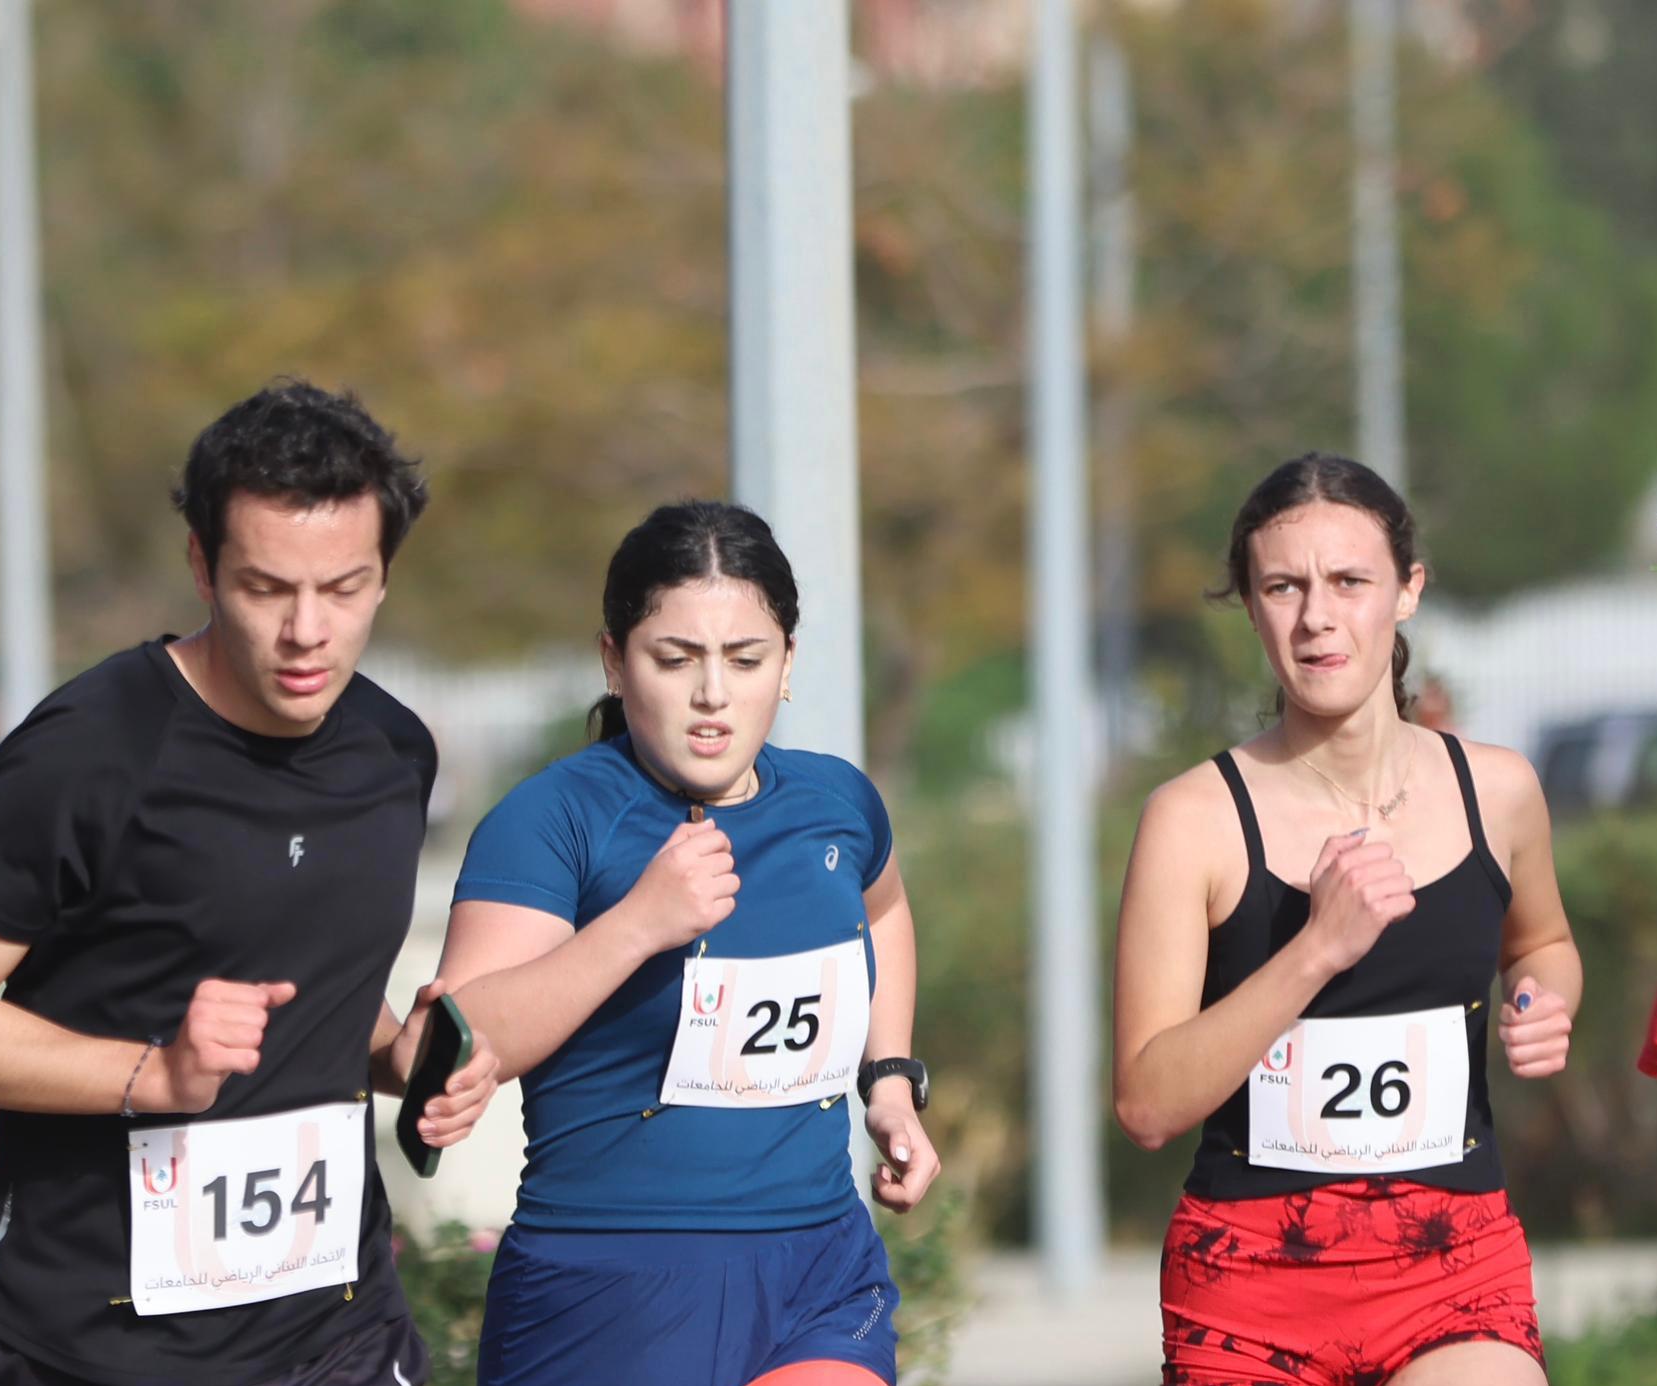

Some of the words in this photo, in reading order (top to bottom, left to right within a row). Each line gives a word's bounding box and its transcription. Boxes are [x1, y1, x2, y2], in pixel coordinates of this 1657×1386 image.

[689, 1018, 719, 1028] FSUL
[740, 994, 821, 1056] 25
[1260, 1073, 1292, 1086] FSUL
[1320, 1060, 1411, 1119] 26
[143, 1198, 179, 1210] FSUL
[202, 1159, 333, 1241] 154
